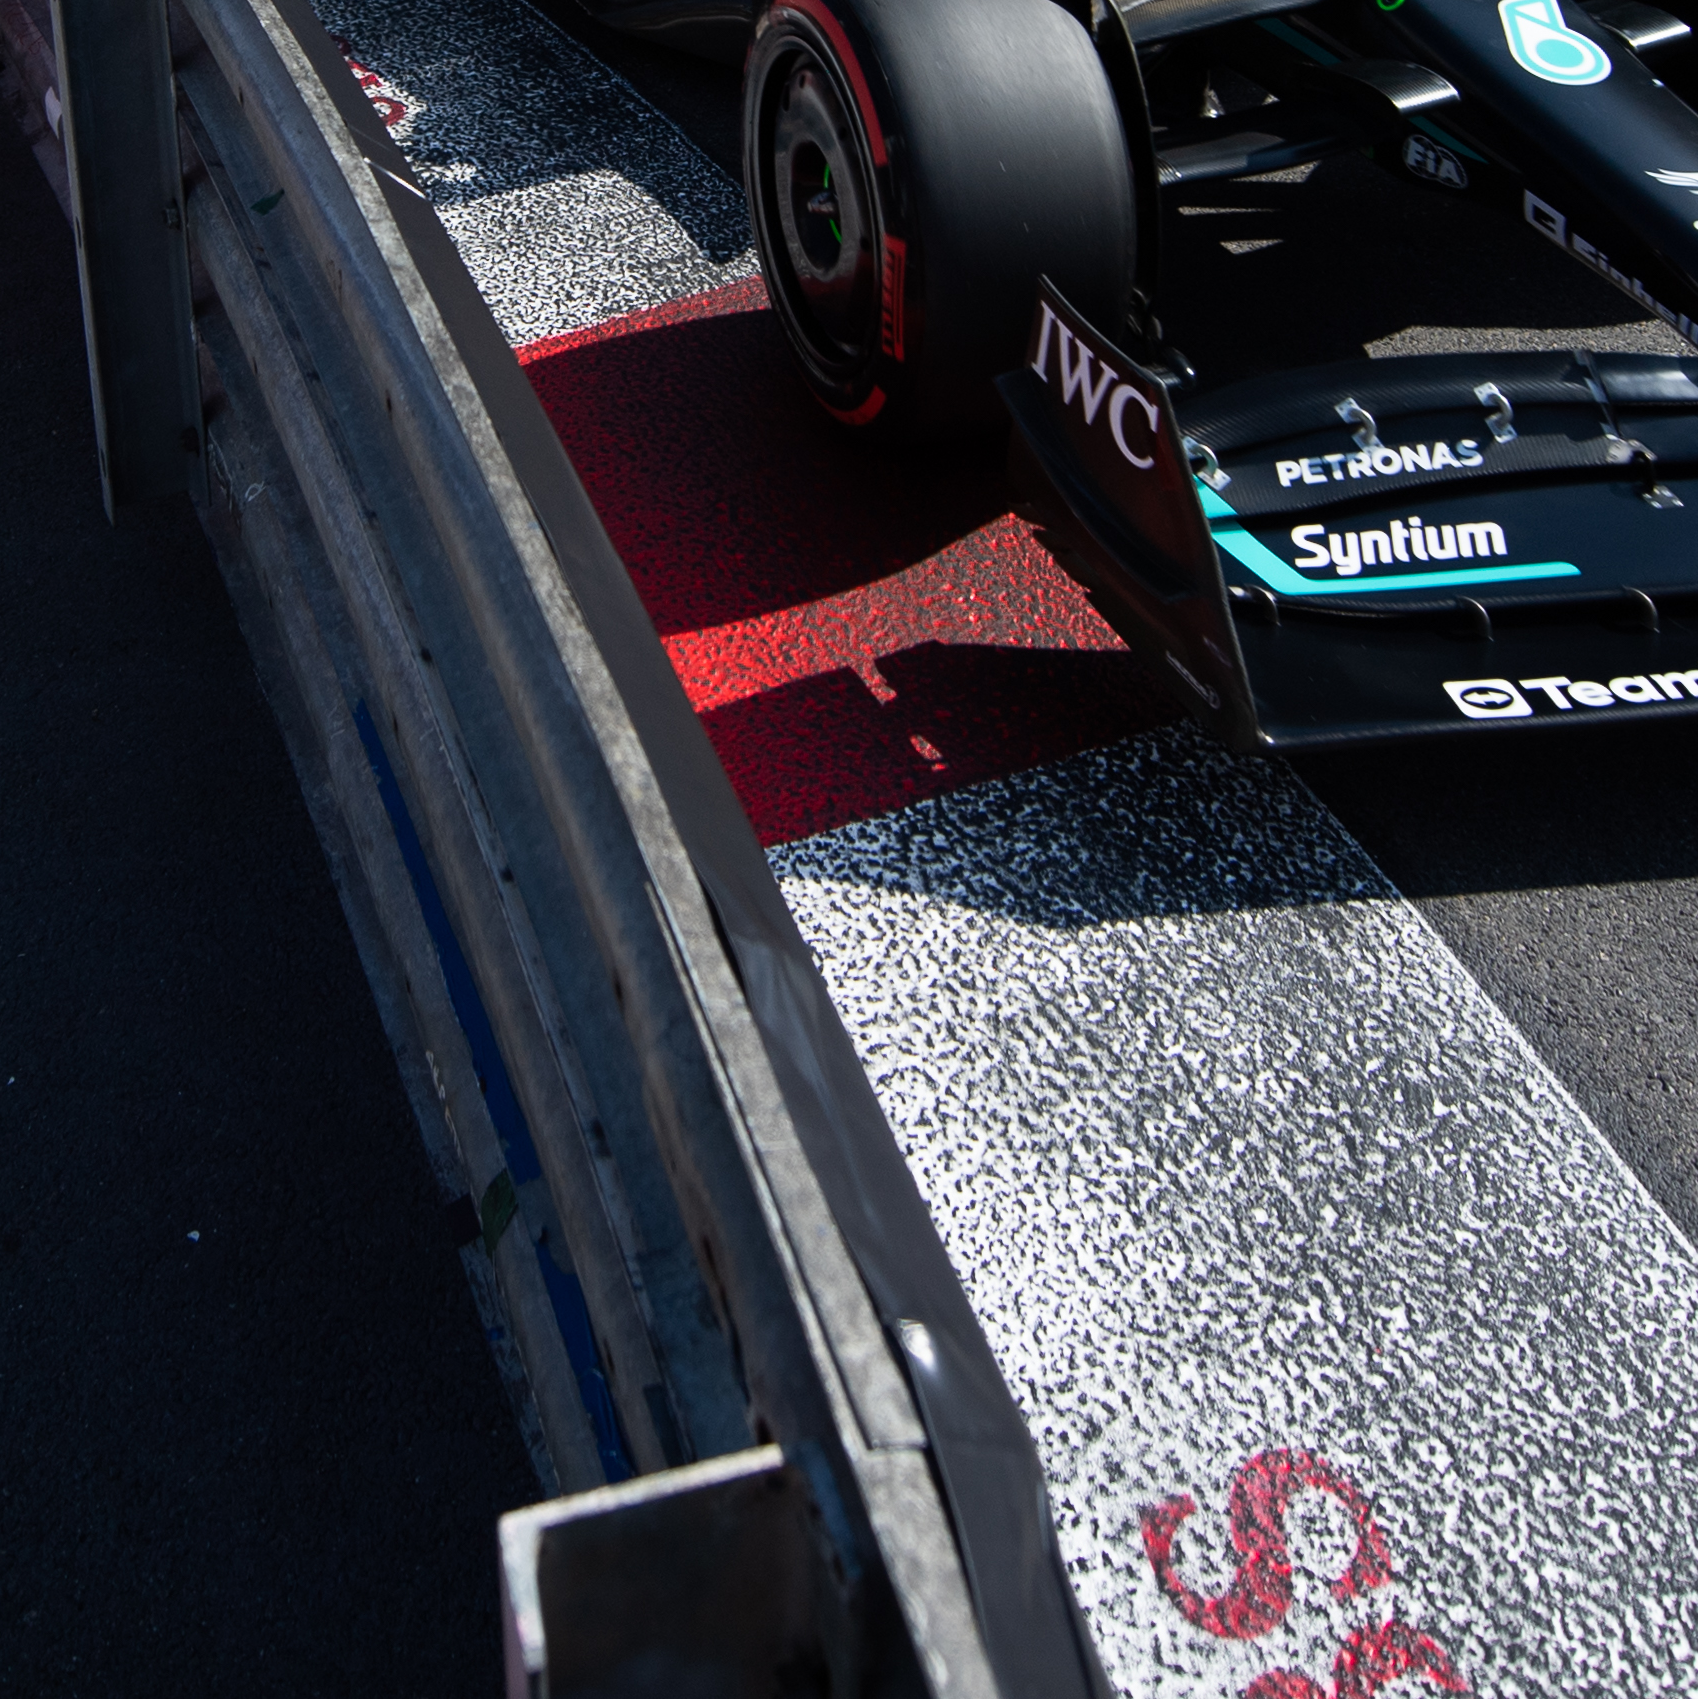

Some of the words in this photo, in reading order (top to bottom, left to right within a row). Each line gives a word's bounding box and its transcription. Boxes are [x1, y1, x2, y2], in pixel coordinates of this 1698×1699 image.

[1406, 138, 1462, 185] FIA
[1030, 299, 1161, 471] IWC
[1275, 438, 1484, 488] PETRONAS
[1290, 514, 1508, 577] Syntium
